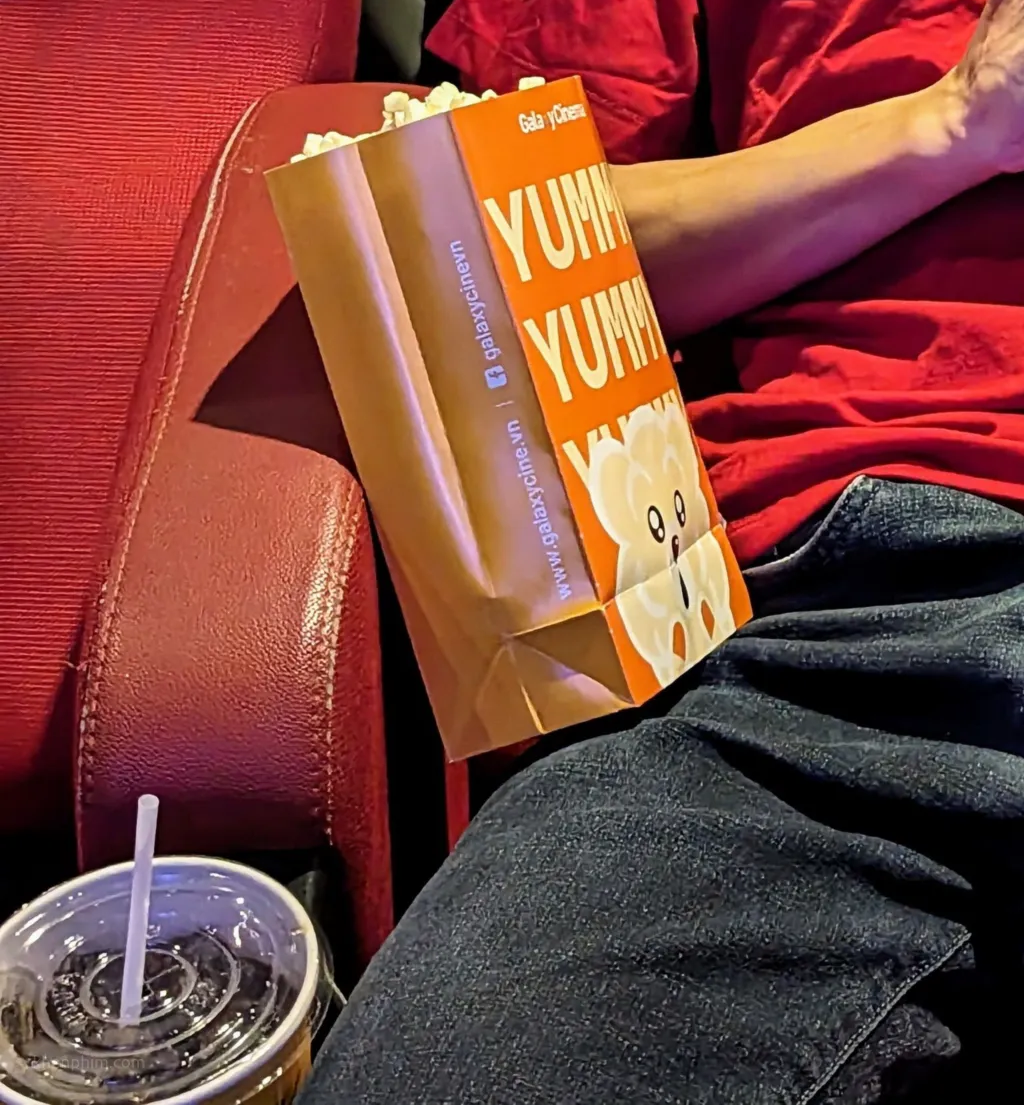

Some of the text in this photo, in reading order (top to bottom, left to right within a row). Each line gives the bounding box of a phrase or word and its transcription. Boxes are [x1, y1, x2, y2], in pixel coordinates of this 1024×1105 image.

[483, 162, 632, 282] YUMM
[523, 274, 667, 403] YUMM
[450, 240, 573, 600] www.galaxycine.vn galaxycinevn
